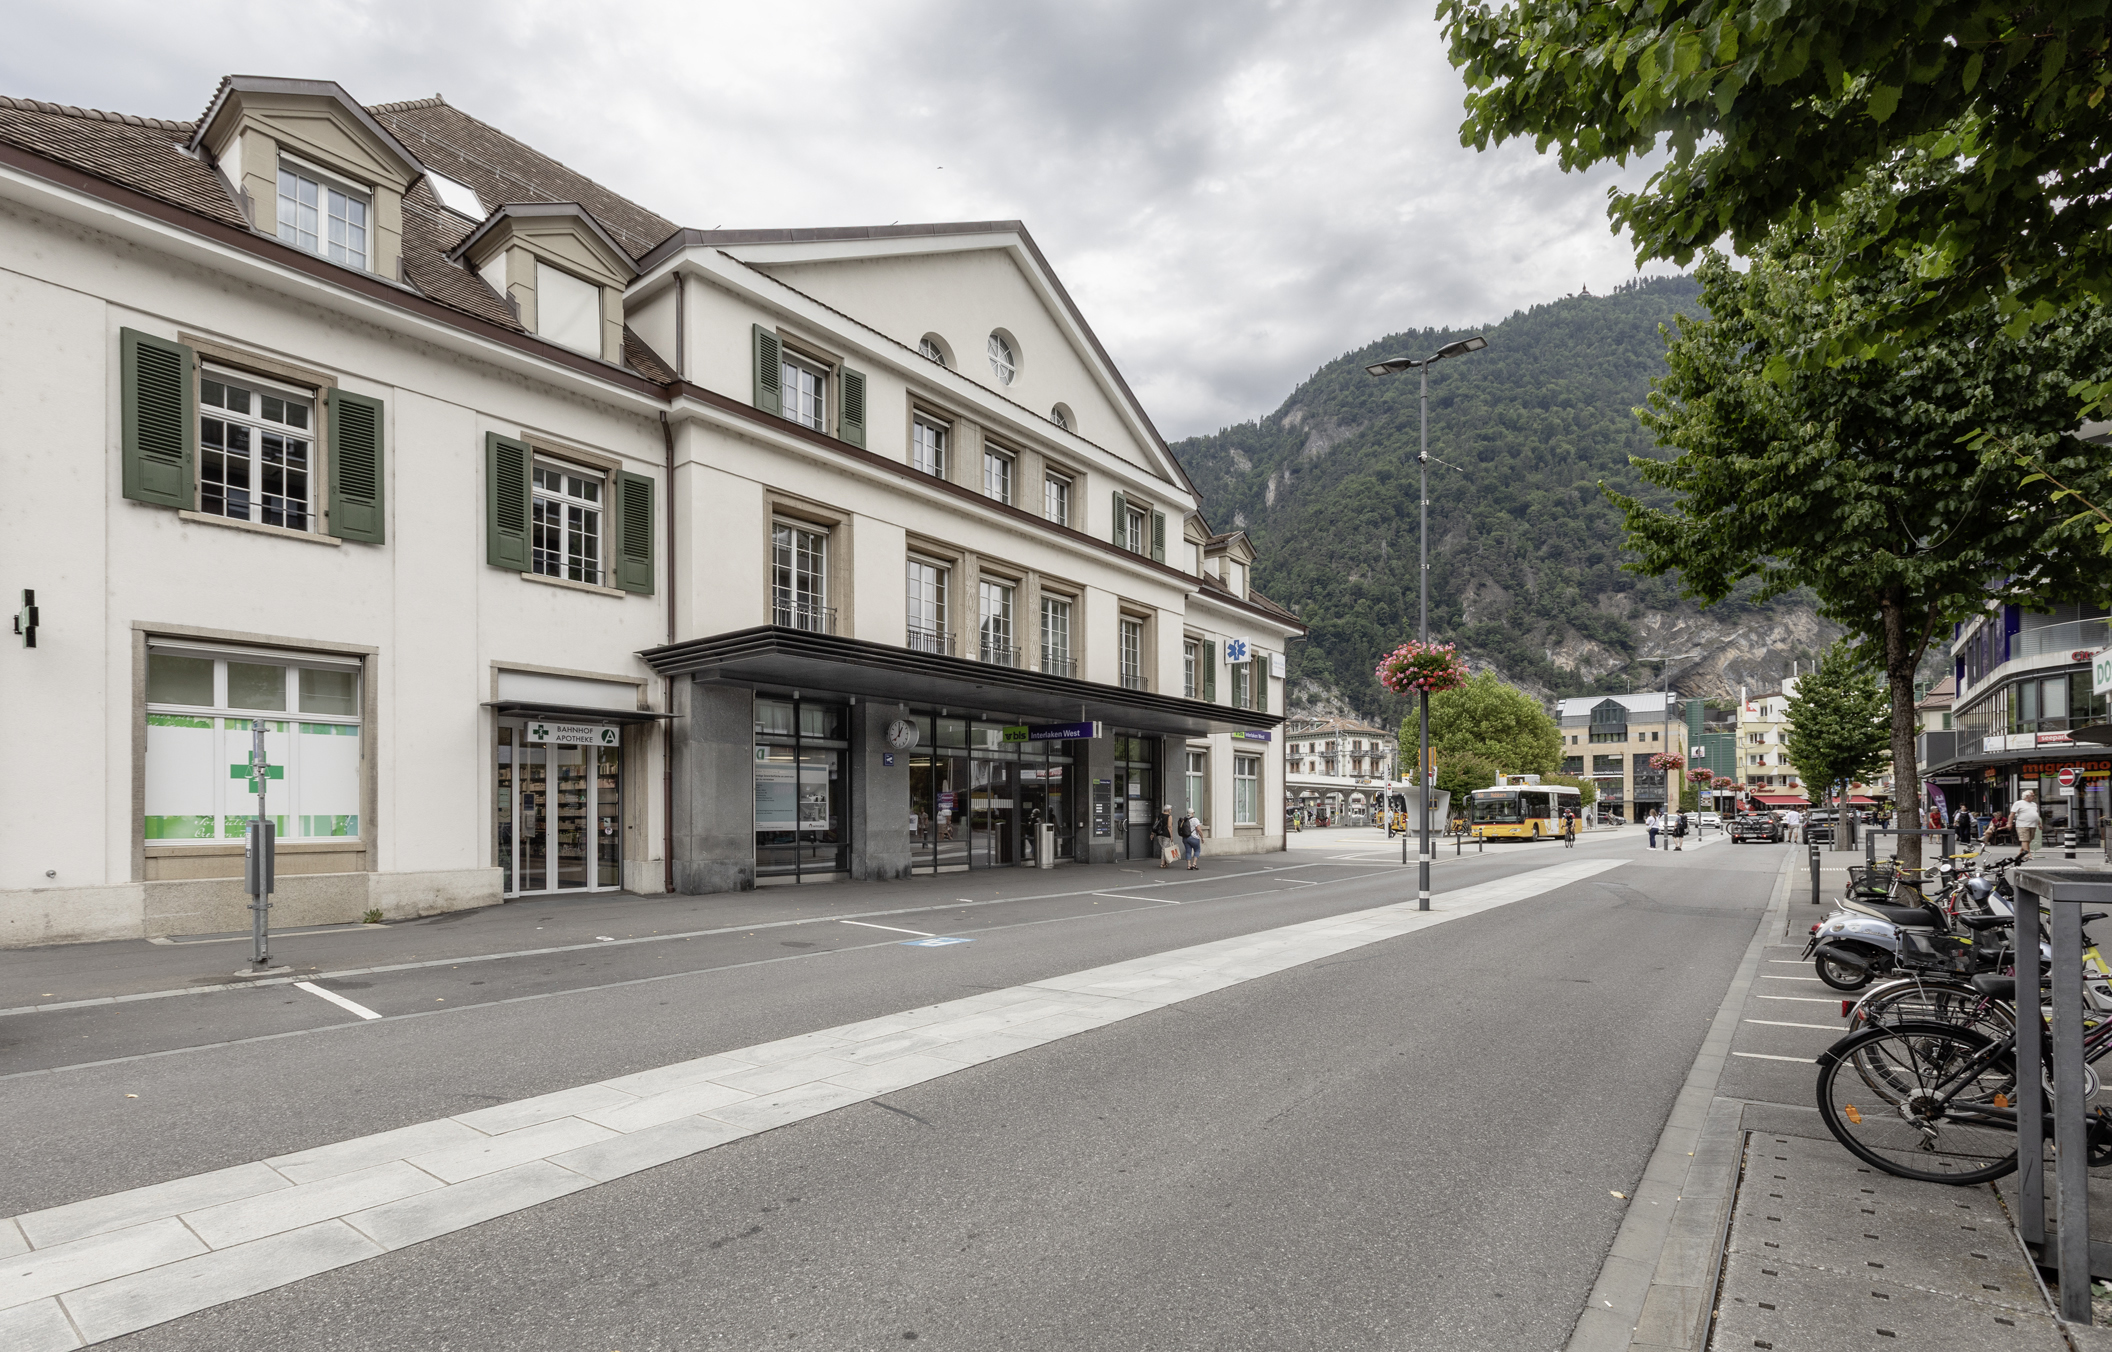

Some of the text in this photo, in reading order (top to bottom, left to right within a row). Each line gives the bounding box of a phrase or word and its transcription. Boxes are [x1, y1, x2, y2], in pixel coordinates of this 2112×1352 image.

[2097, 660, 2112, 685] DO
[557, 725, 594, 735] BAHNHOF
[1013, 729, 1081, 739] bls Interlaken West
[556, 735, 594, 743] APOTHEKE
[2041, 733, 2069, 742] seepark
[2022, 761, 2112, 776] migrolino
